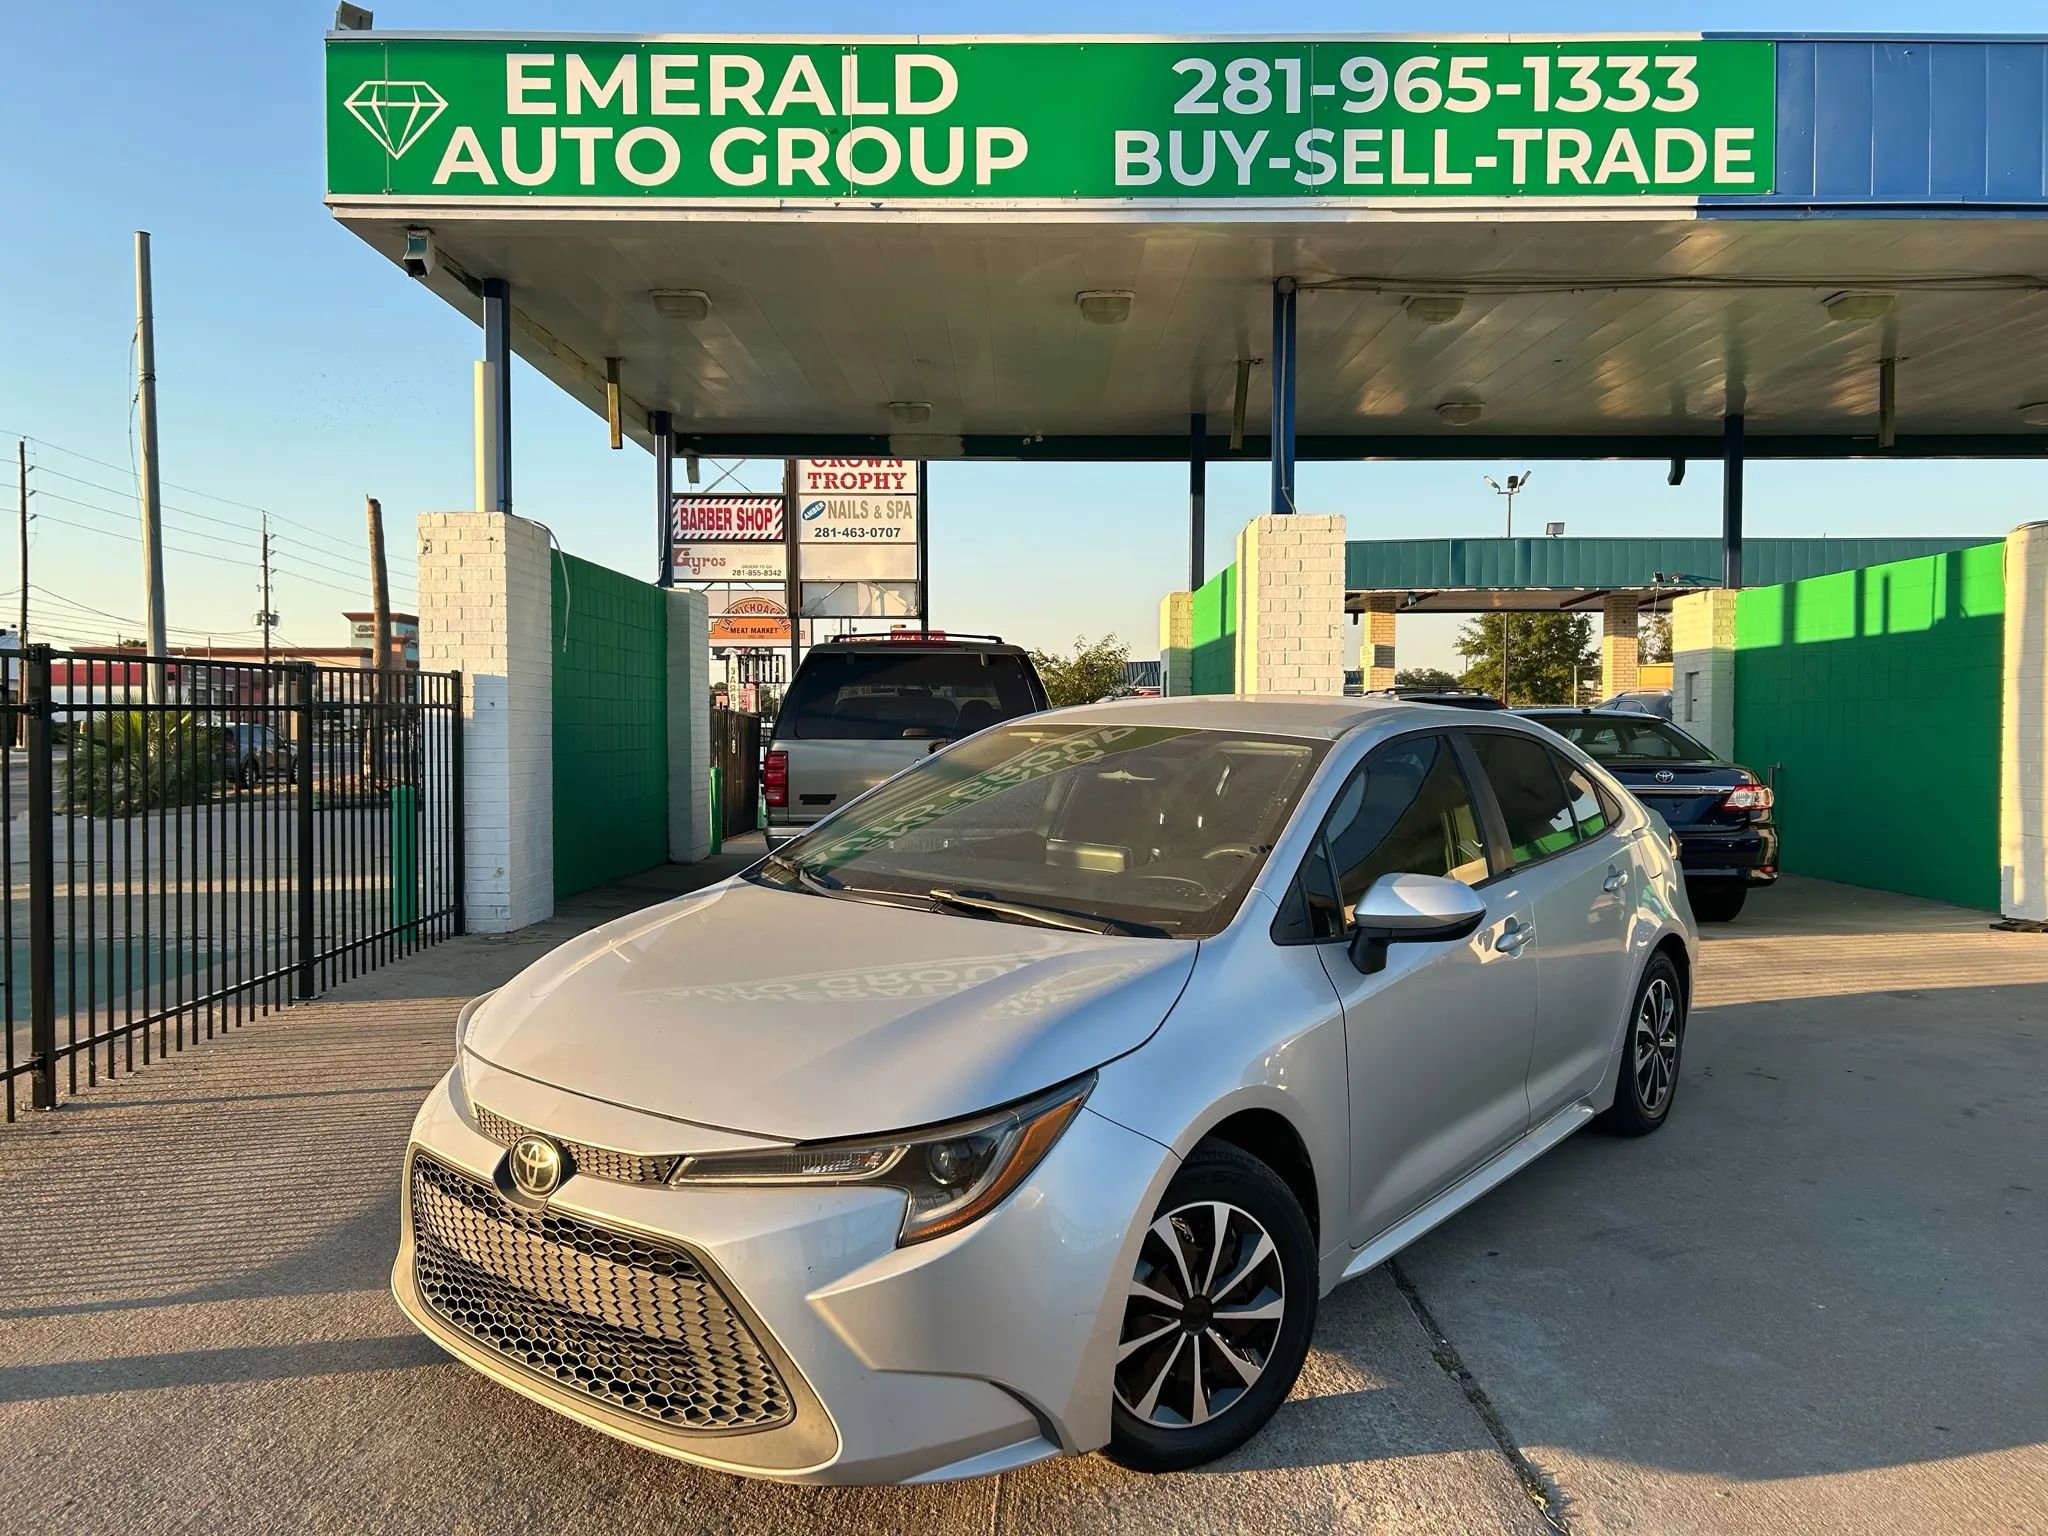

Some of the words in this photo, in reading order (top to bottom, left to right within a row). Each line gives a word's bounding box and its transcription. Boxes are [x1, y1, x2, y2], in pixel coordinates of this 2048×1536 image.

[506, 53, 959, 116] EMERALD
[1171, 54, 1700, 115] 281-965-1333
[431, 125, 681, 187] AUTO
[709, 125, 1029, 187] GROUP
[1114, 127, 1756, 187] BUY-SELL-TRADE
[807, 472, 907, 490] TROPHY
[680, 507, 733, 531] BARBER
[737, 507, 773, 531] SHOP
[803, 502, 826, 520] AMBER
[827, 500, 869, 520] NAILS
[873, 505, 882, 520] &
[886, 500, 913, 520] SPA
[814, 527, 901, 538] 281-463-0707
[672, 548, 727, 575] Gyros
[732, 569, 782, 577] 281-855-8342
